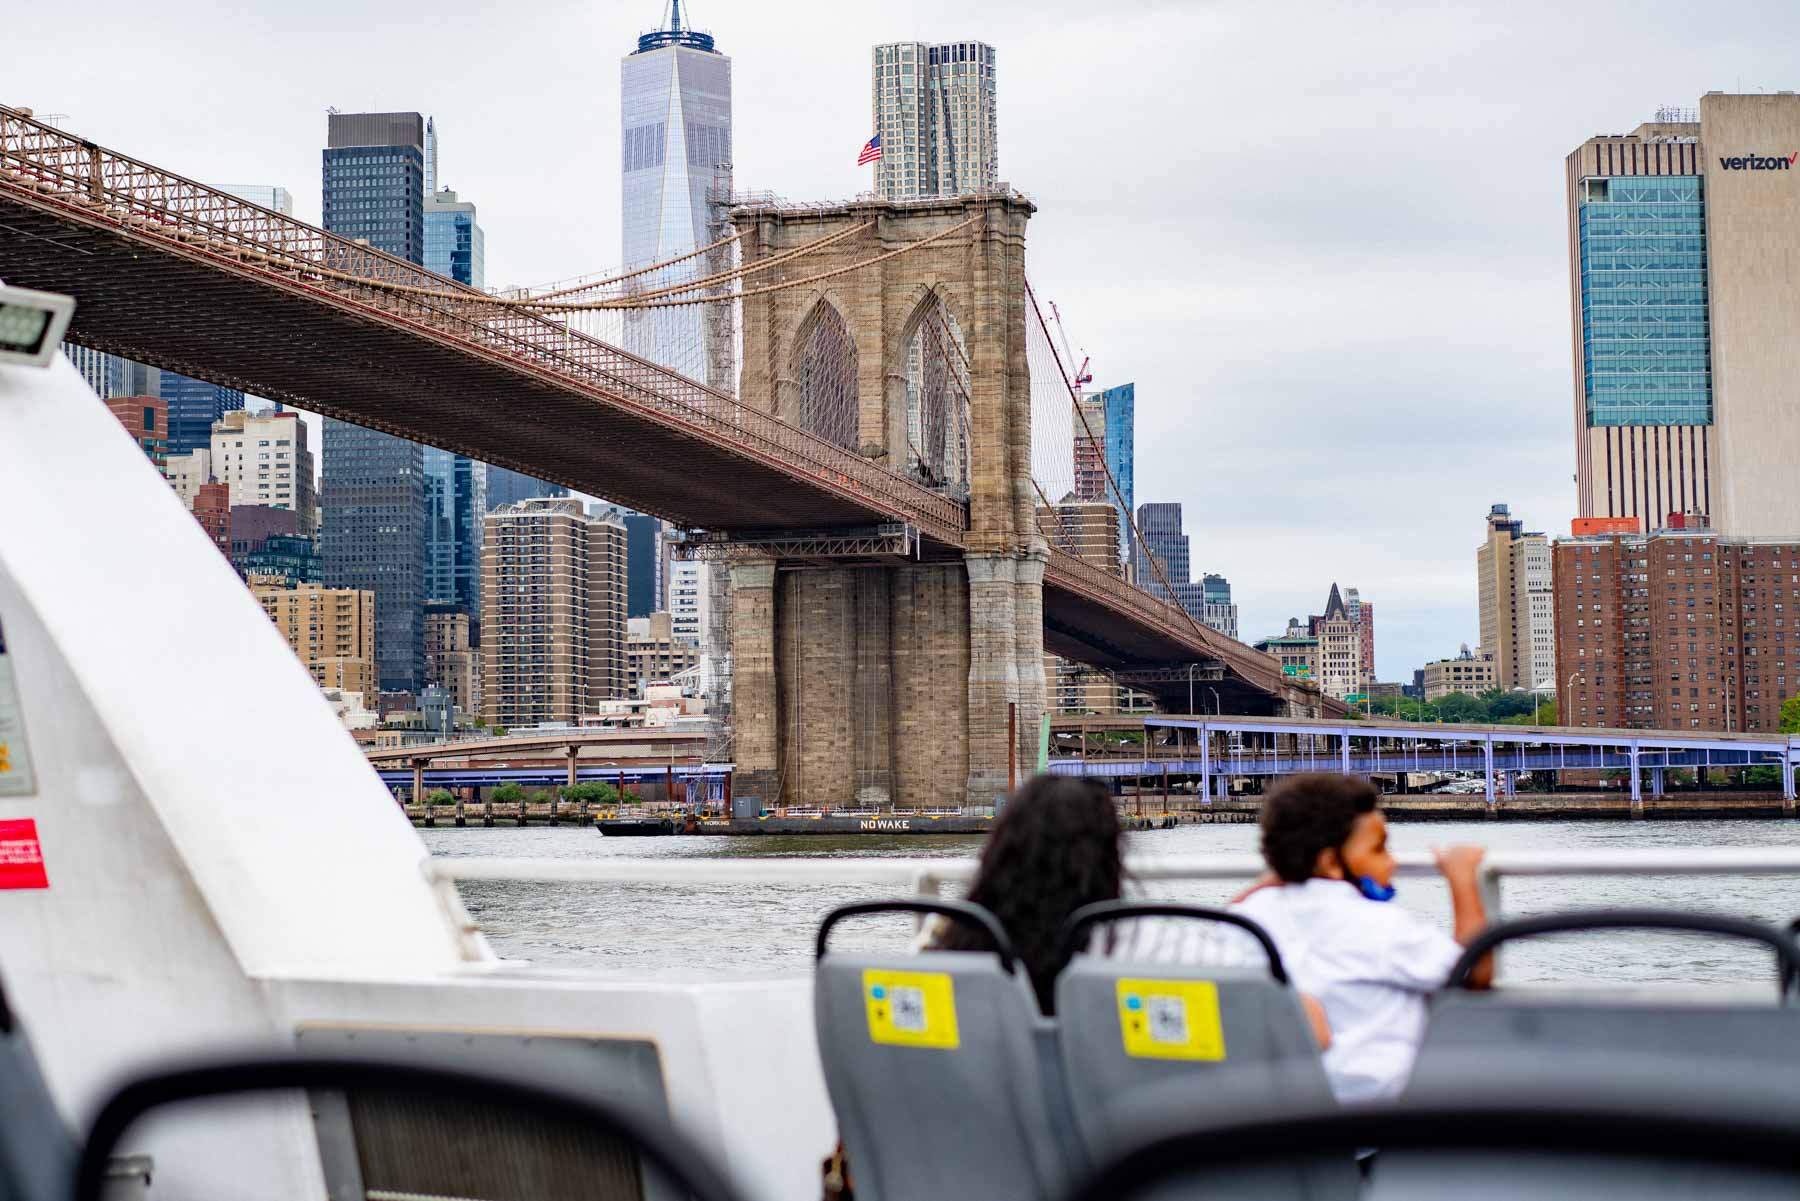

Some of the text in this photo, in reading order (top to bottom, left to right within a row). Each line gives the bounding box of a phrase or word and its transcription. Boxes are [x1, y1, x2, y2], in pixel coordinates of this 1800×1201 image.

[1719, 153, 1789, 170] verizon
[860, 820, 910, 829] NO WAKE
